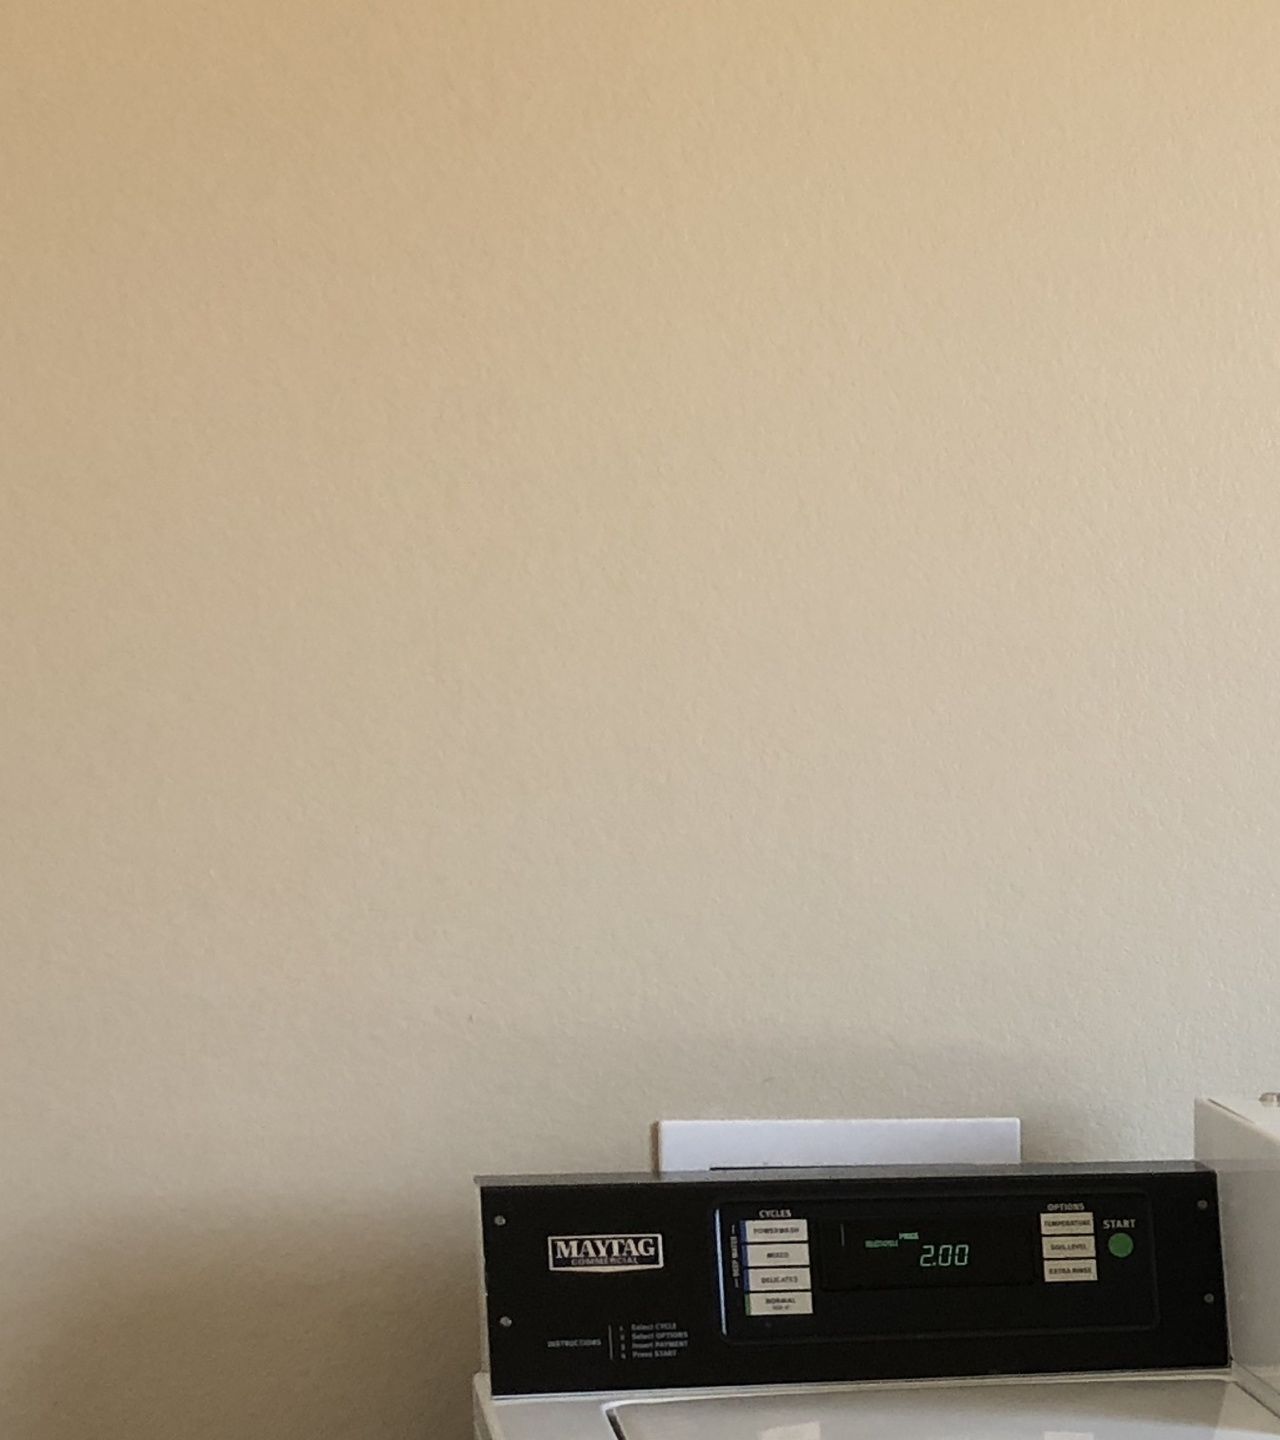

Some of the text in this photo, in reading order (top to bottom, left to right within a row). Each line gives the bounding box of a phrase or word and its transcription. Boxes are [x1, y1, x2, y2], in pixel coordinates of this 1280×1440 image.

[1046, 1202, 1085, 1211] OPTIONS
[759, 1209, 792, 1218] CYCLES
[1102, 1218, 1136, 1229] START
[554, 1238, 656, 1258] MAYTAG
[920, 1244, 969, 1267] 2.00
